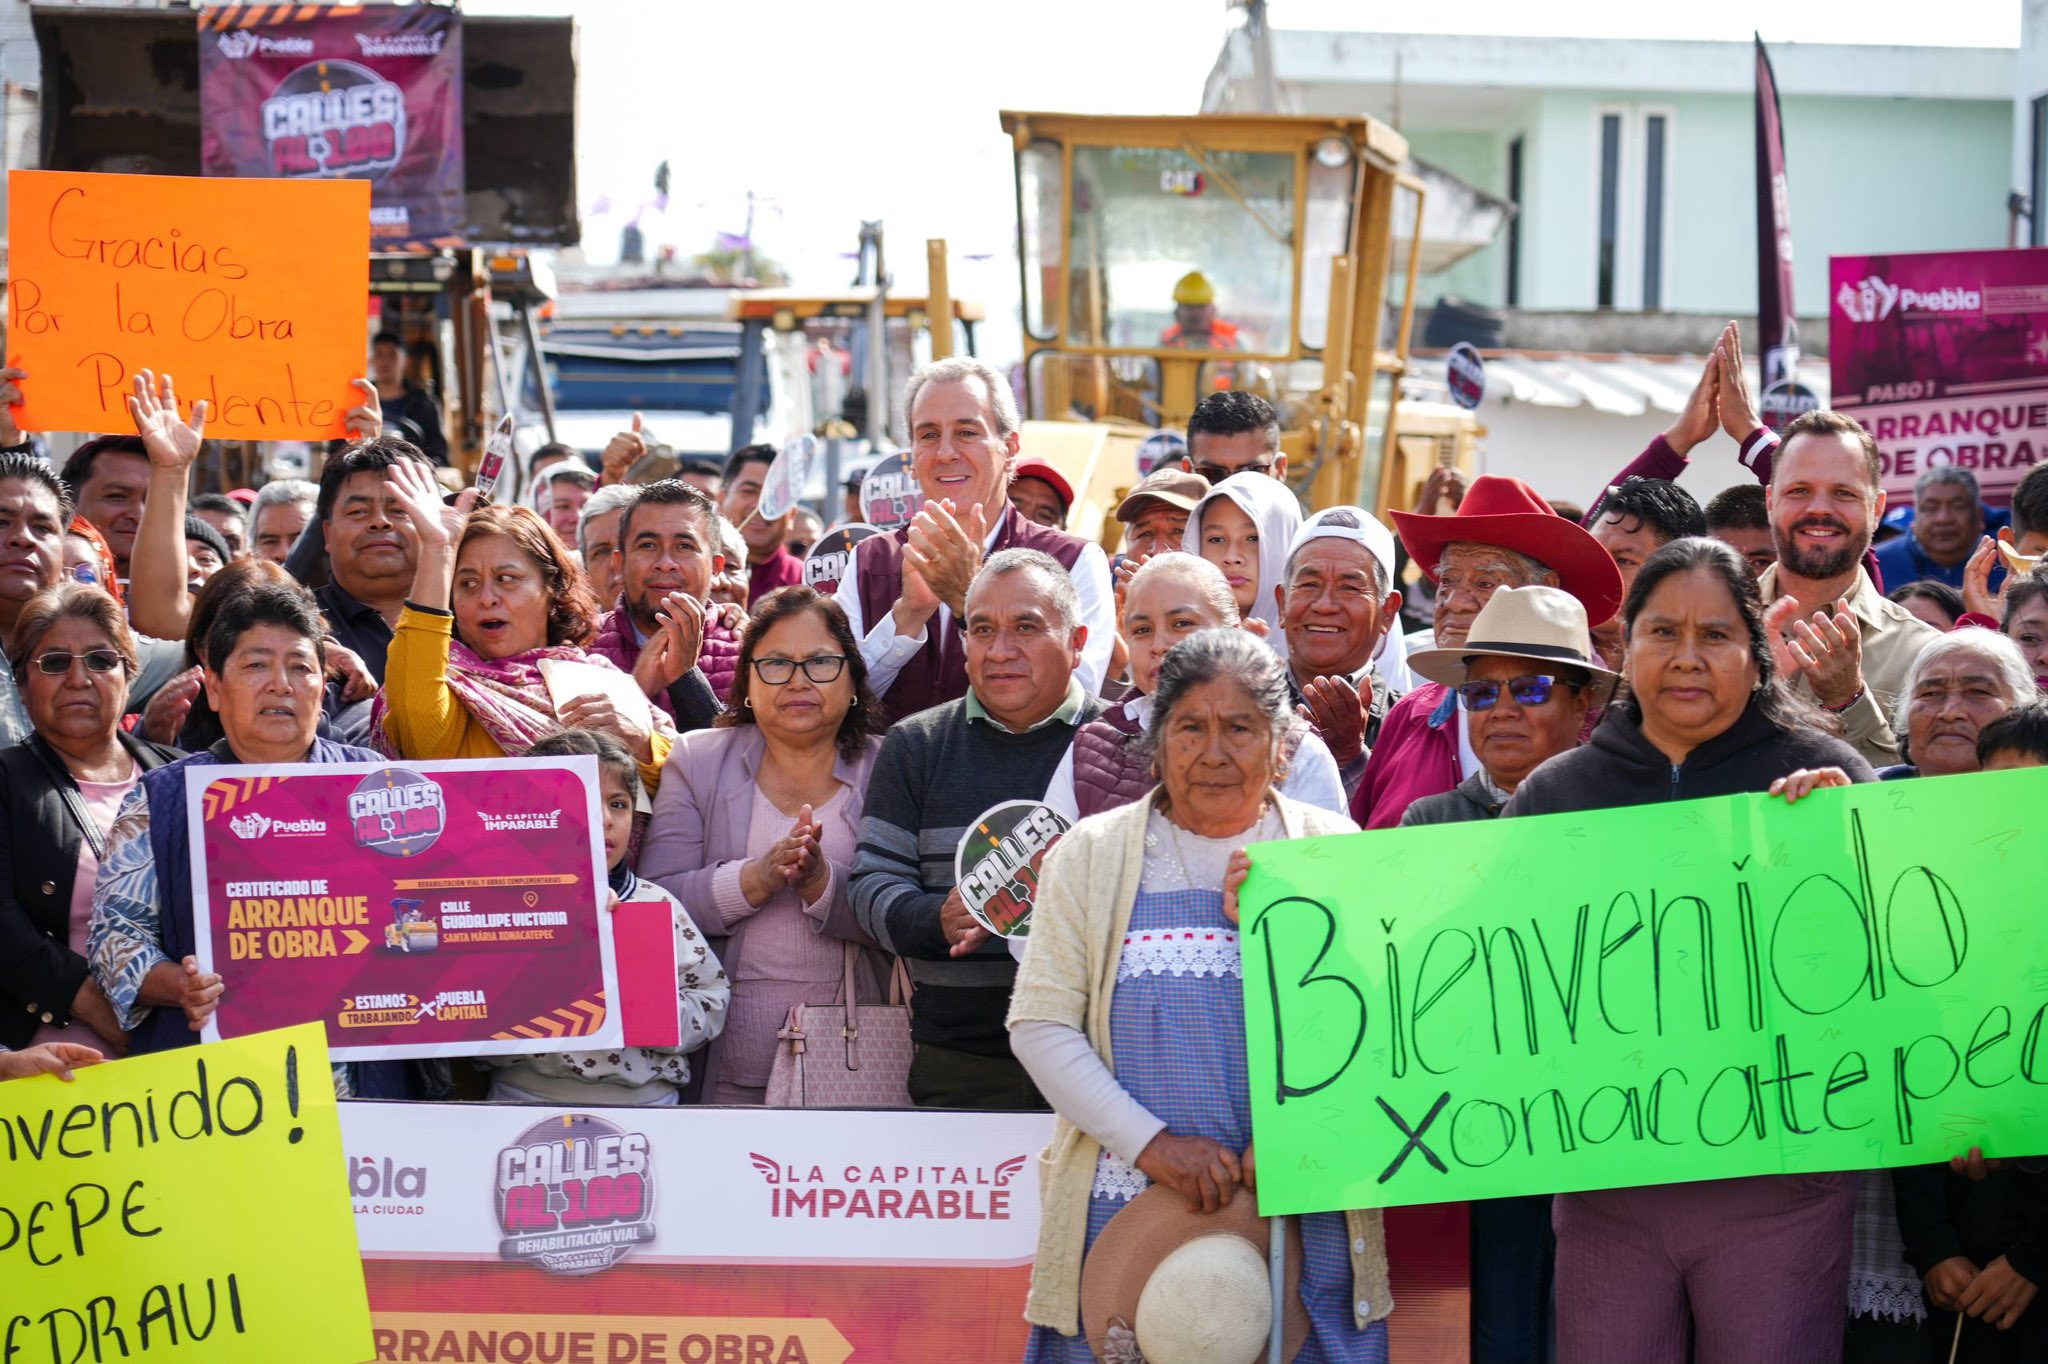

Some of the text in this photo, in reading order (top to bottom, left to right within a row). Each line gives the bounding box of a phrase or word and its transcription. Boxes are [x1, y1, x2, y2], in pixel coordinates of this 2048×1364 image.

[263, 85, 400, 140] CALLES
[274, 134, 318, 173] AL
[50, 187, 248, 280] Gracias
[9, 278, 294, 342] Por la Obra
[1900, 287, 1980, 311] Puebla
[76, 352, 335, 428] Prdente
[1867, 381, 1923, 403] PASO
[1927, 440, 2037, 469] OBRA
[349, 783, 440, 820] CALLES
[272, 819, 326, 833] Puebla
[357, 805, 439, 840] AL 100
[485, 819, 558, 831] IMPARABLE
[960, 806, 1061, 911] CALLES
[226, 880, 328, 897] CERTIFICADO DE
[228, 896, 370, 929] ARRANQUE
[440, 901, 471, 913] CALLE
[442, 911, 568, 929] GUADALUPE VICTORIA
[983, 886, 1029, 934] AL
[229, 929, 338, 960] DE OBRA
[443, 932, 470, 943] SANTA
[498, 929, 554, 941] XONACATEPEC
[1251, 807, 1968, 1105] Bienvenido
[346, 1005, 488, 1025] TRABAJANDO CAPITAL!
[355, 993, 407, 1010] ESTAMOS
[348, 1155, 428, 1199] bla
[499, 1133, 647, 1190] CALLES
[788, 1165, 989, 1185] LA CAPITAL
[353, 1205, 425, 1215] LA CIUDAD
[504, 1172, 642, 1229] AL 100
[771, 1187, 1012, 1221] IMPARABLE
[517, 1227, 640, 1254] REHABILITACIÓN VIAL
[551, 1257, 609, 1270] IMPARABLE
[372, 1328, 808, 1364] RRANQUE DE OBRA
